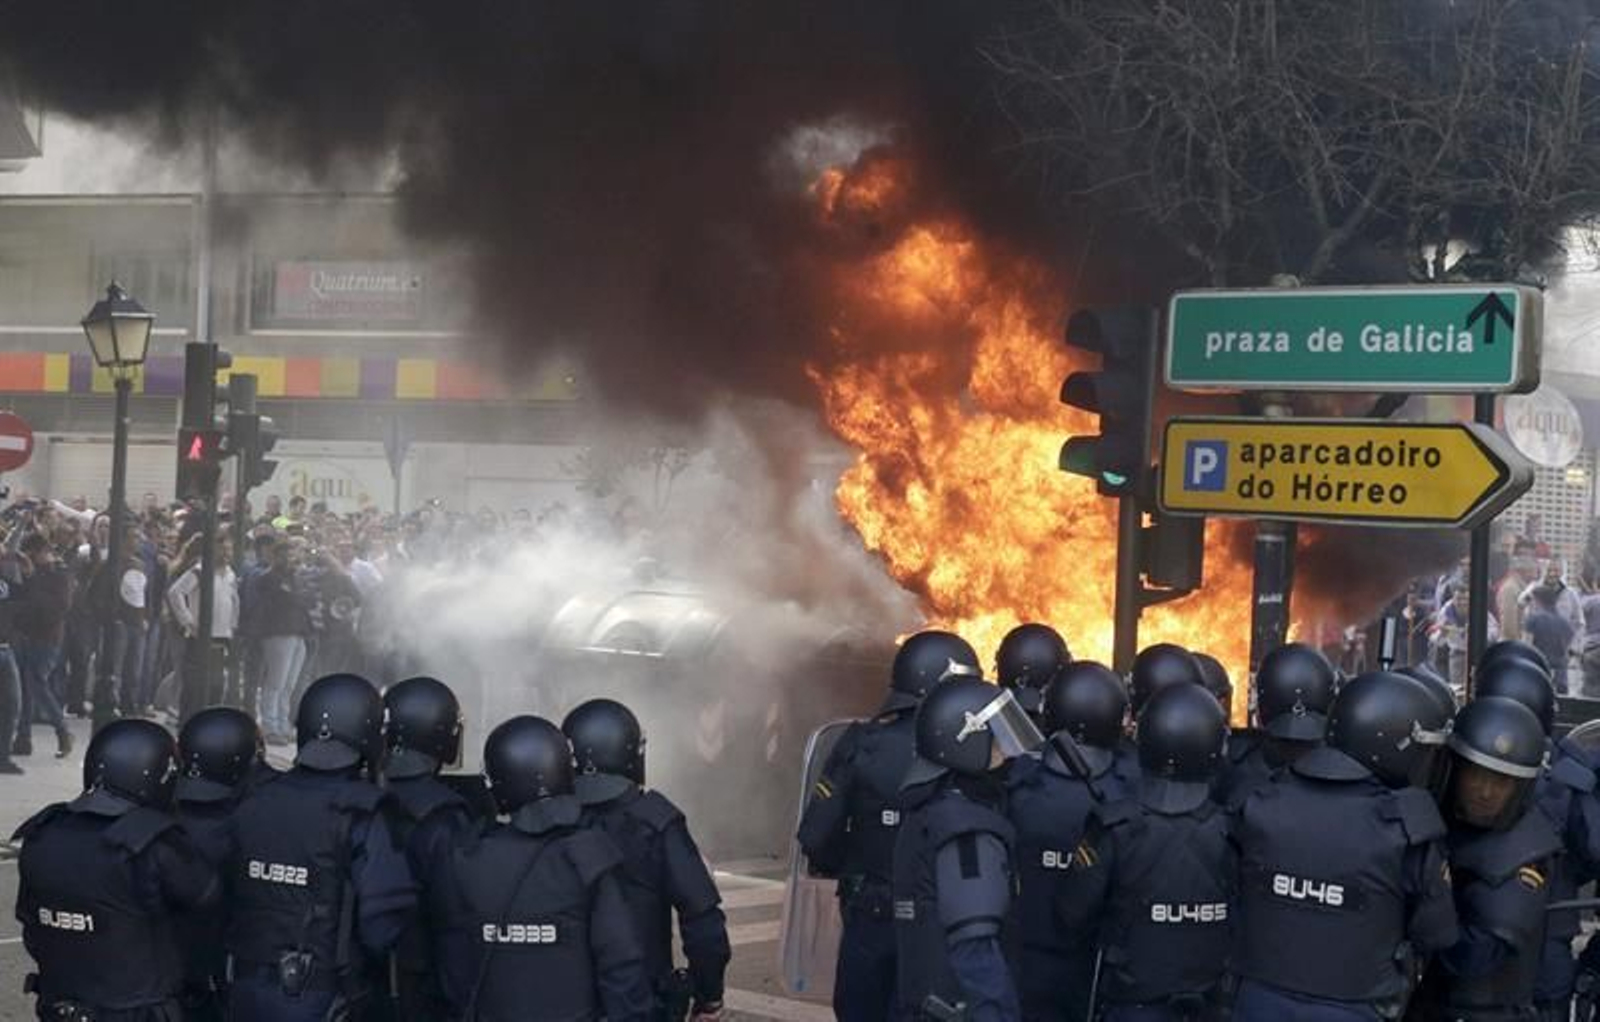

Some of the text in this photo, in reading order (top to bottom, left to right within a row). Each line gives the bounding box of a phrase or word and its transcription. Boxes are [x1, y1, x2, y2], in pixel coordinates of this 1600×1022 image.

[1206, 324, 1474, 359] praza de Galicia
[1192, 447, 1219, 484] P
[1240, 440, 1441, 468] aparcadoiro
[1237, 474, 1408, 505] do Hórreo
